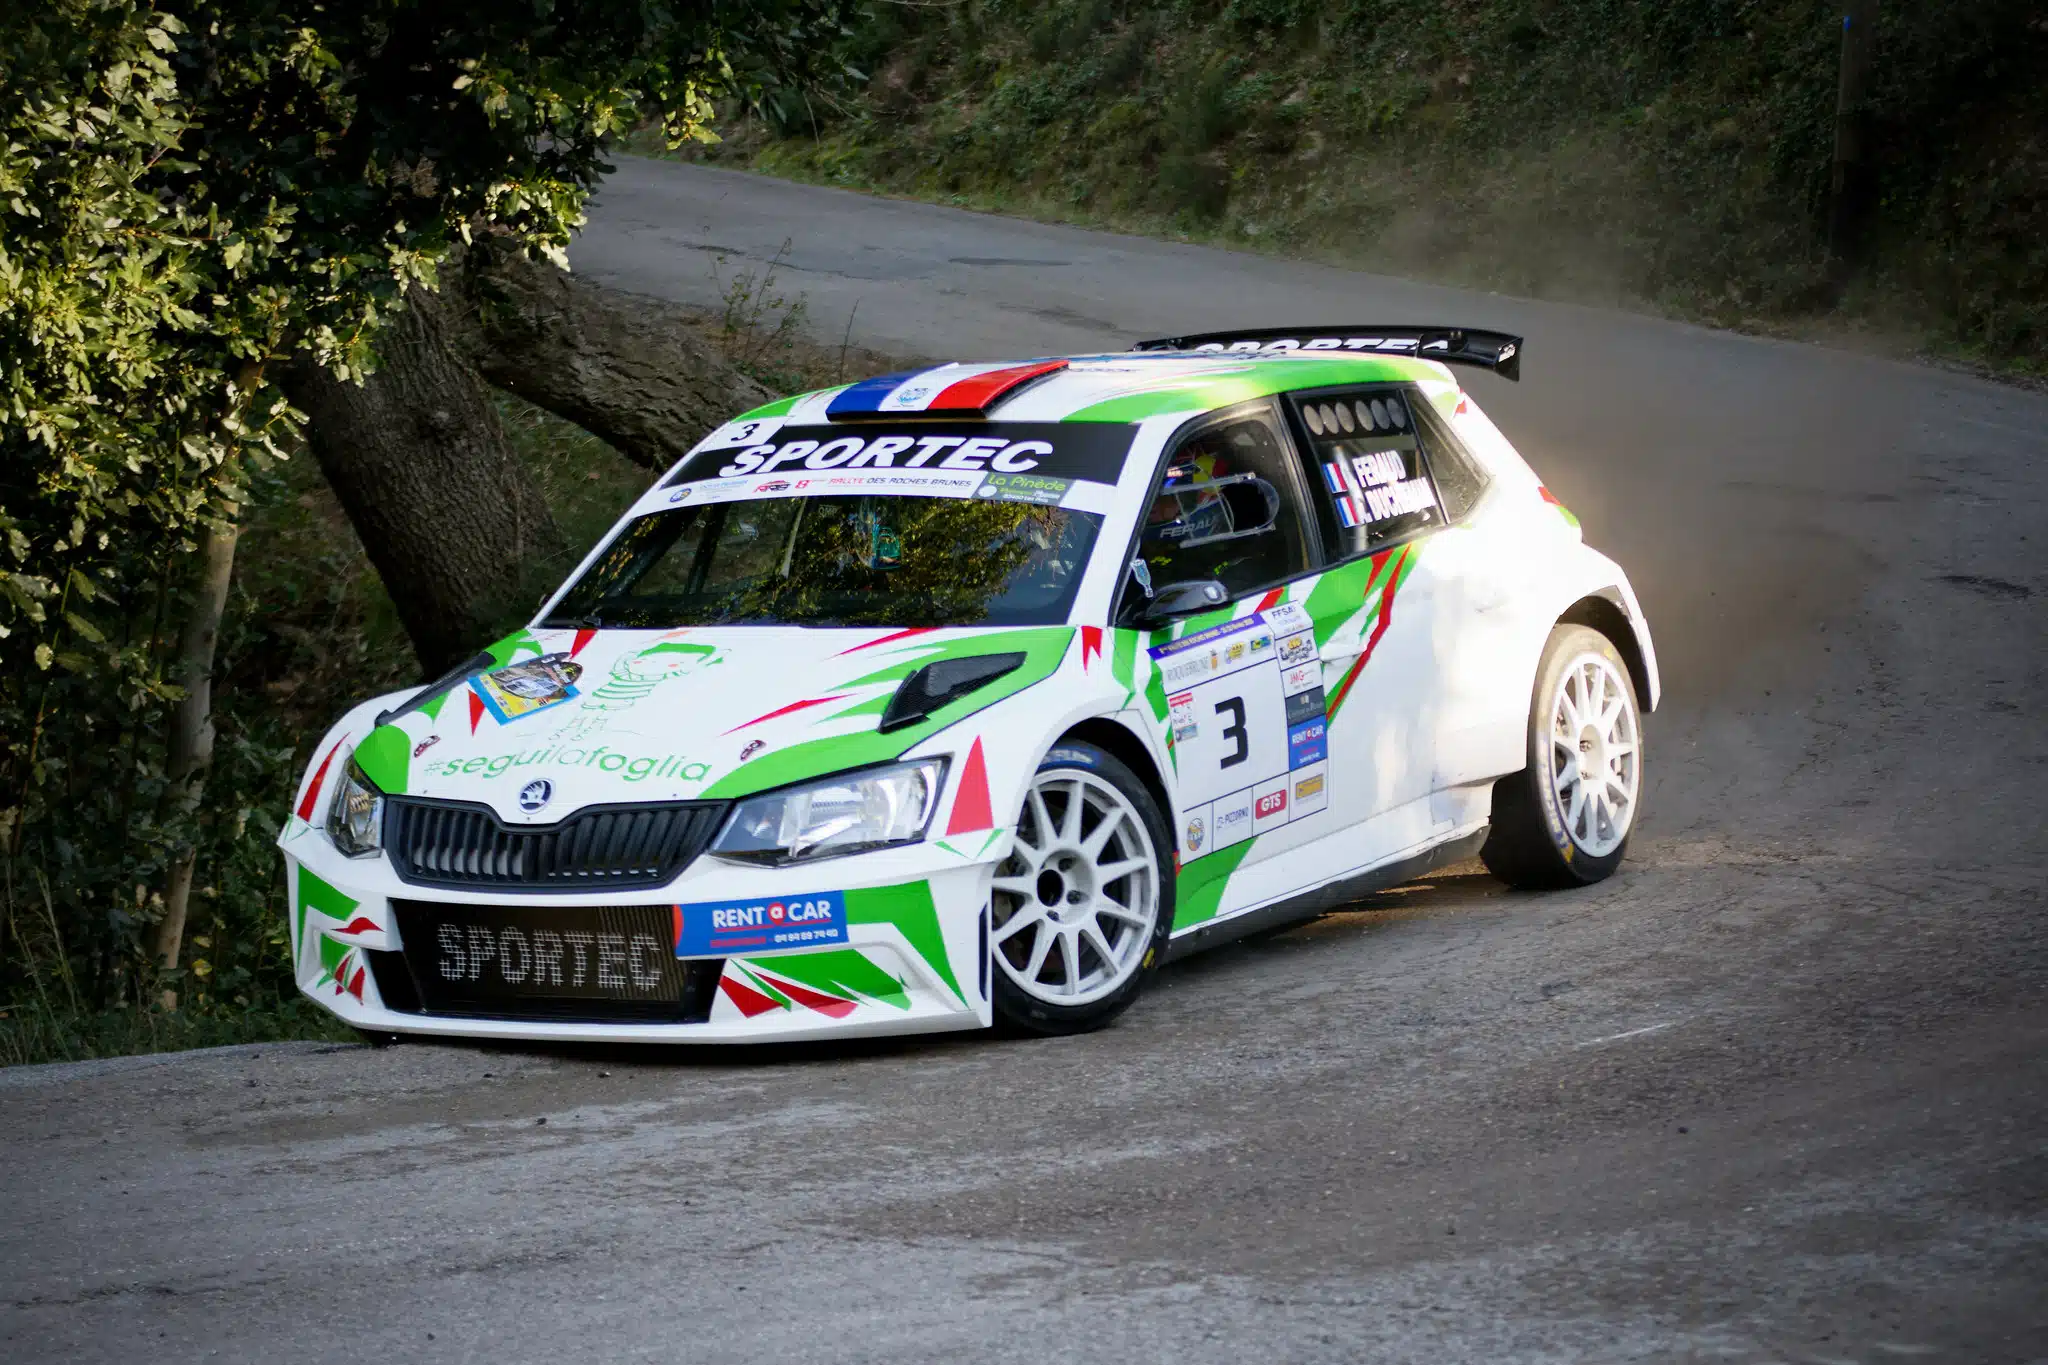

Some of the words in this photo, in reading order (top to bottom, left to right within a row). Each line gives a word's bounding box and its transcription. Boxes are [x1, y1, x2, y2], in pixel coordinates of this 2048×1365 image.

[731, 423, 759, 442] 3
[719, 436, 1054, 478] SPORTEC
[1352, 450, 1407, 488] FERAUD
[828, 477, 864, 485] RALLYE
[866, 477, 886, 485] DES
[888, 477, 928, 485] ROCHES
[931, 478, 972, 487] BRUNES
[1011, 475, 1066, 491] Pinède
[1213, 695, 1249, 770] 3
[1292, 730, 1307, 744] RENT
[1311, 724, 1324, 738] CAR
[423, 744, 714, 783] #seguilafoglia
[1260, 792, 1282, 812] GTS
[712, 905, 765, 929] RENT
[770, 905, 784, 920] a
[787, 900, 832, 922] CAR
[437, 922, 663, 993] SPORTEC
